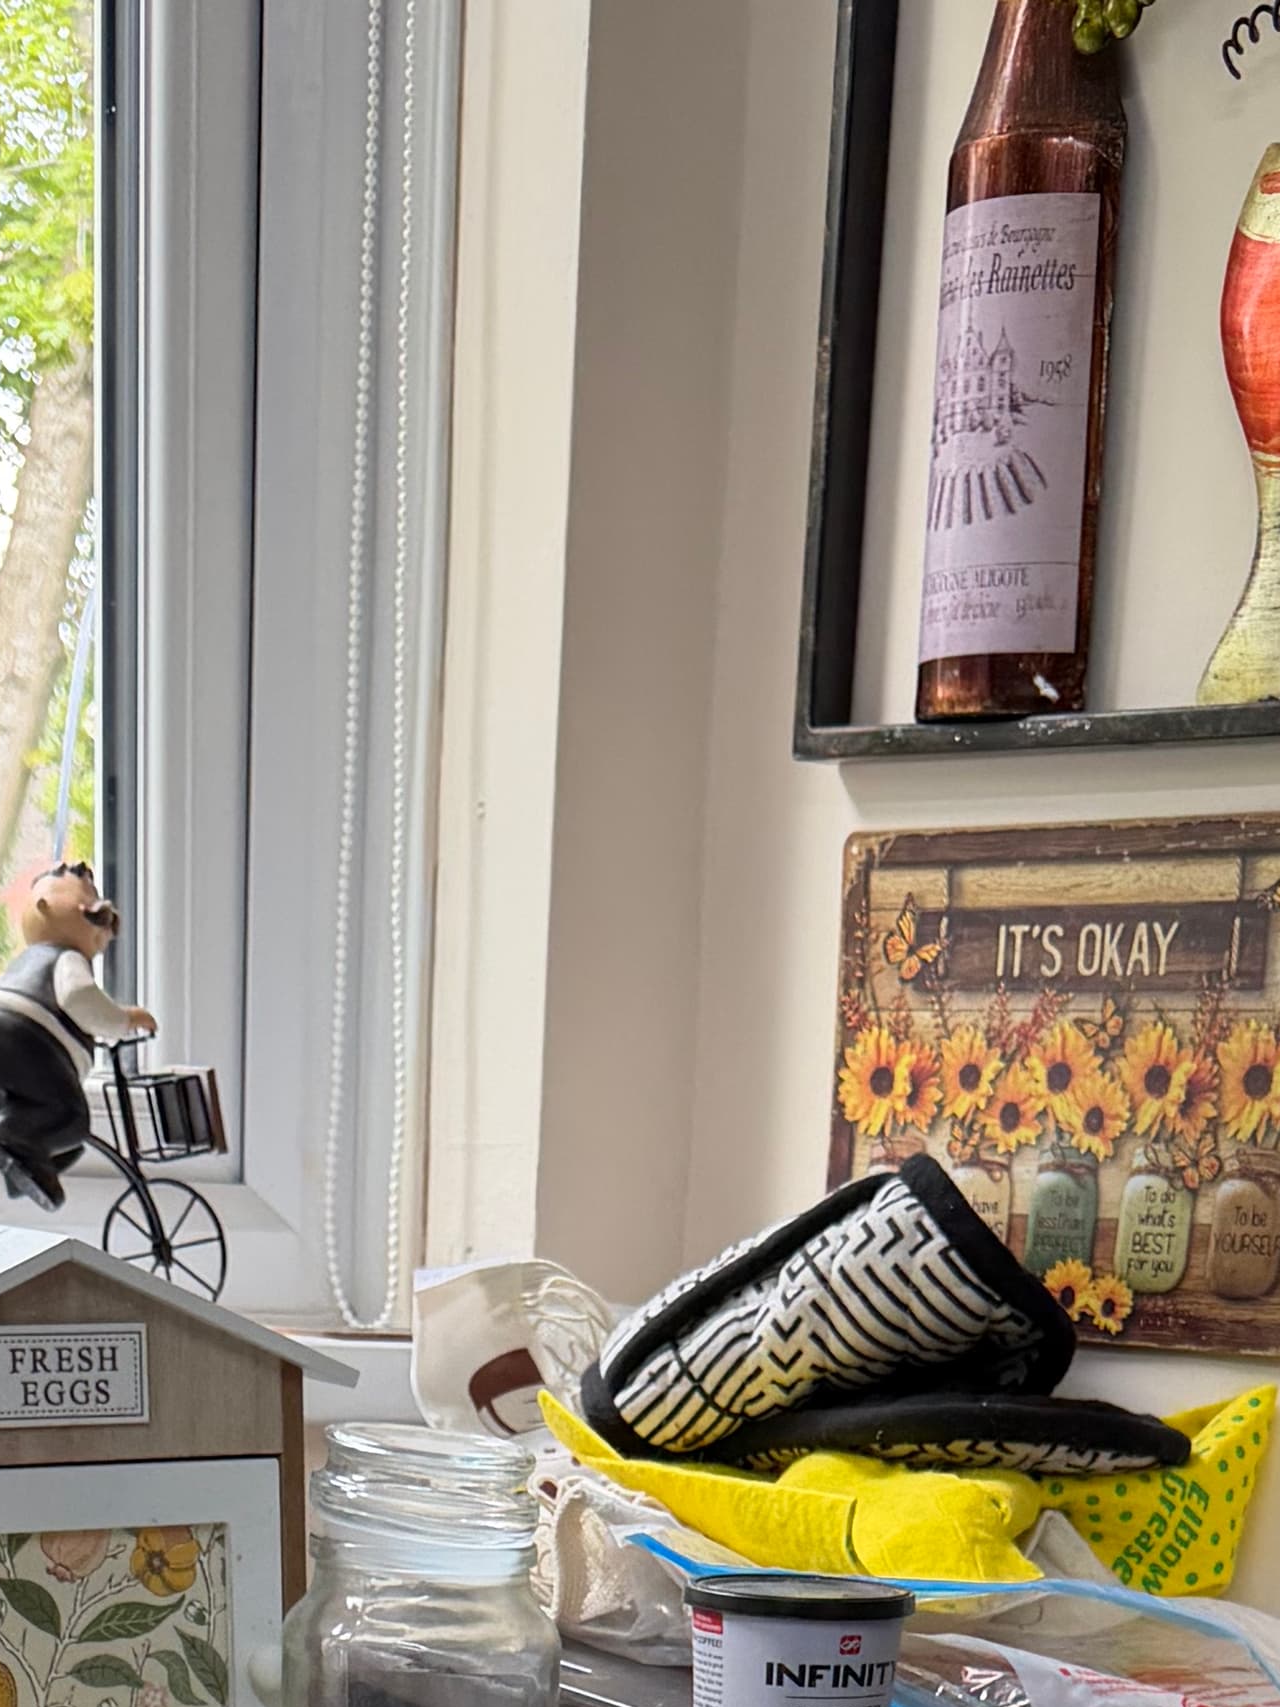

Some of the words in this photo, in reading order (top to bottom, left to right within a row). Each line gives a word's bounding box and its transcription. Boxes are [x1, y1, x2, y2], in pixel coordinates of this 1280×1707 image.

[1039, 353, 1073, 383] 1958
[996, 924, 1064, 978] IT'S
[1077, 921, 1180, 977] OKAY
[1144, 1185, 1157, 1203] To
[1160, 1187, 1176, 1205] do
[1234, 1206, 1247, 1226] To
[1251, 1204, 1267, 1227] be
[1131, 1231, 1176, 1256] BEST
[1151, 1259, 1174, 1278] you
[9, 1346, 119, 1374] FRESH
[21, 1379, 110, 1406] EGGS
[1111, 1471, 1187, 1585] Grease
[1141, 1480, 1210, 1594] Elbow
